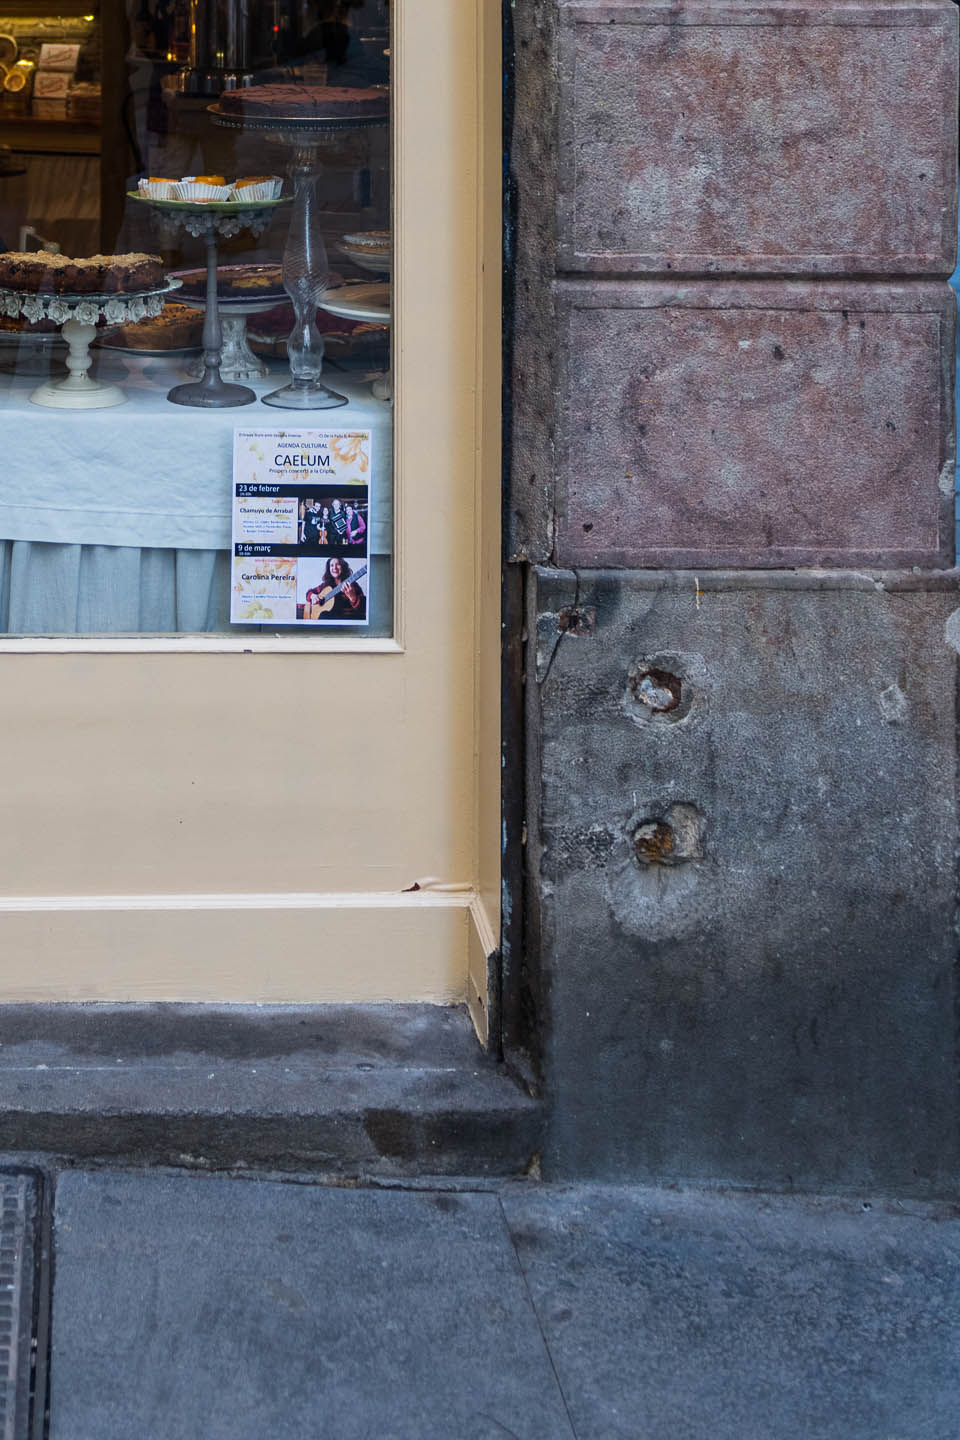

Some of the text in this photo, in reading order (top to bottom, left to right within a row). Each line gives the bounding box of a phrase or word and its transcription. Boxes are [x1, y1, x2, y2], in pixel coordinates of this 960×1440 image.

[274, 454, 330, 467] CAELUM
[253, 545, 272, 553] març
[241, 573, 269, 581] Carolina
